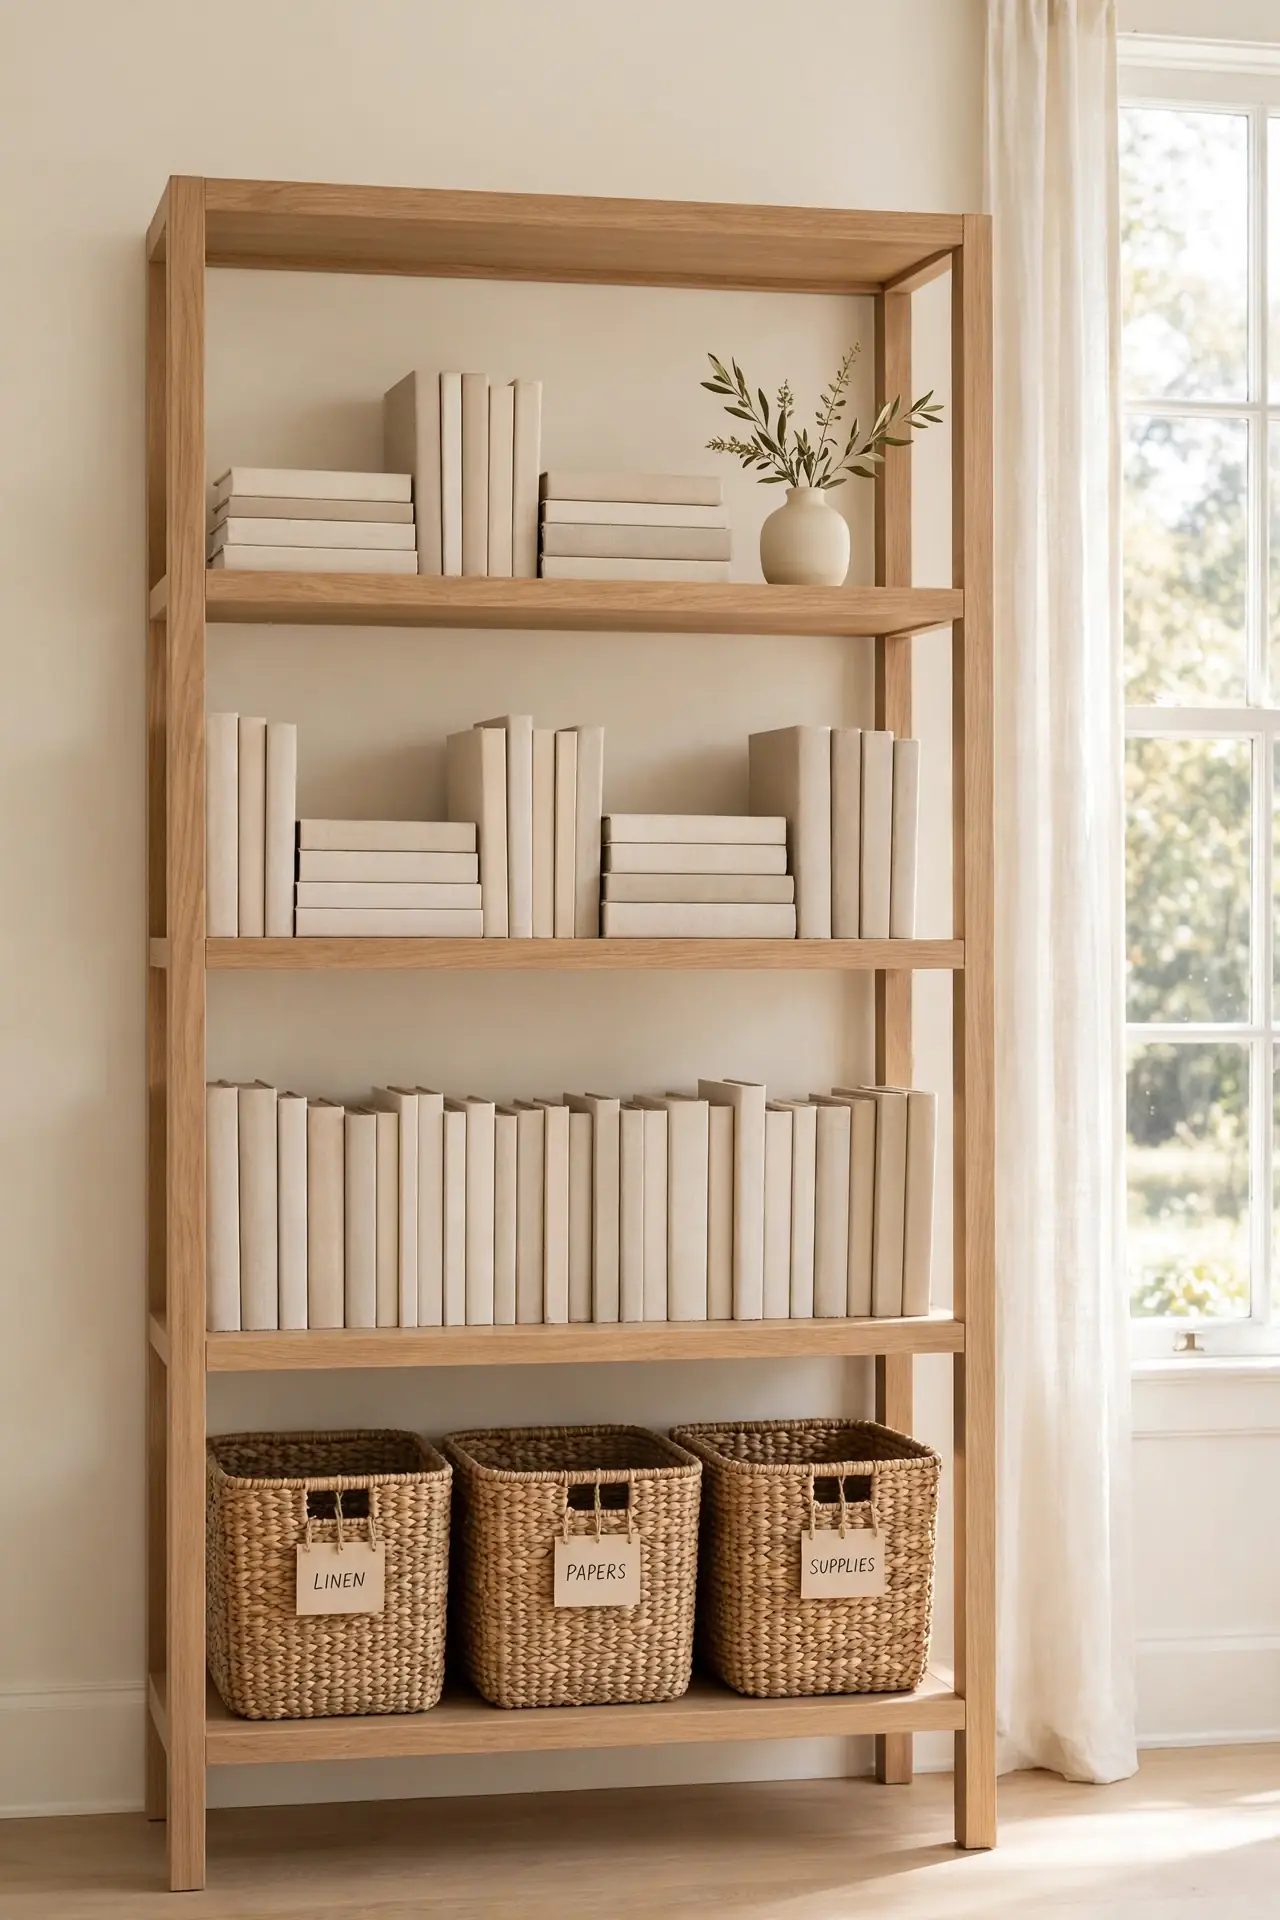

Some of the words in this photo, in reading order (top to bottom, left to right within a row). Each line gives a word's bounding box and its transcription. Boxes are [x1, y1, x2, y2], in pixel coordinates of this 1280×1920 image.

[566, 1563, 626, 1582] PAPERS
[809, 1557, 875, 1575] SUPPLIES
[313, 1571, 366, 1590] LINEN
